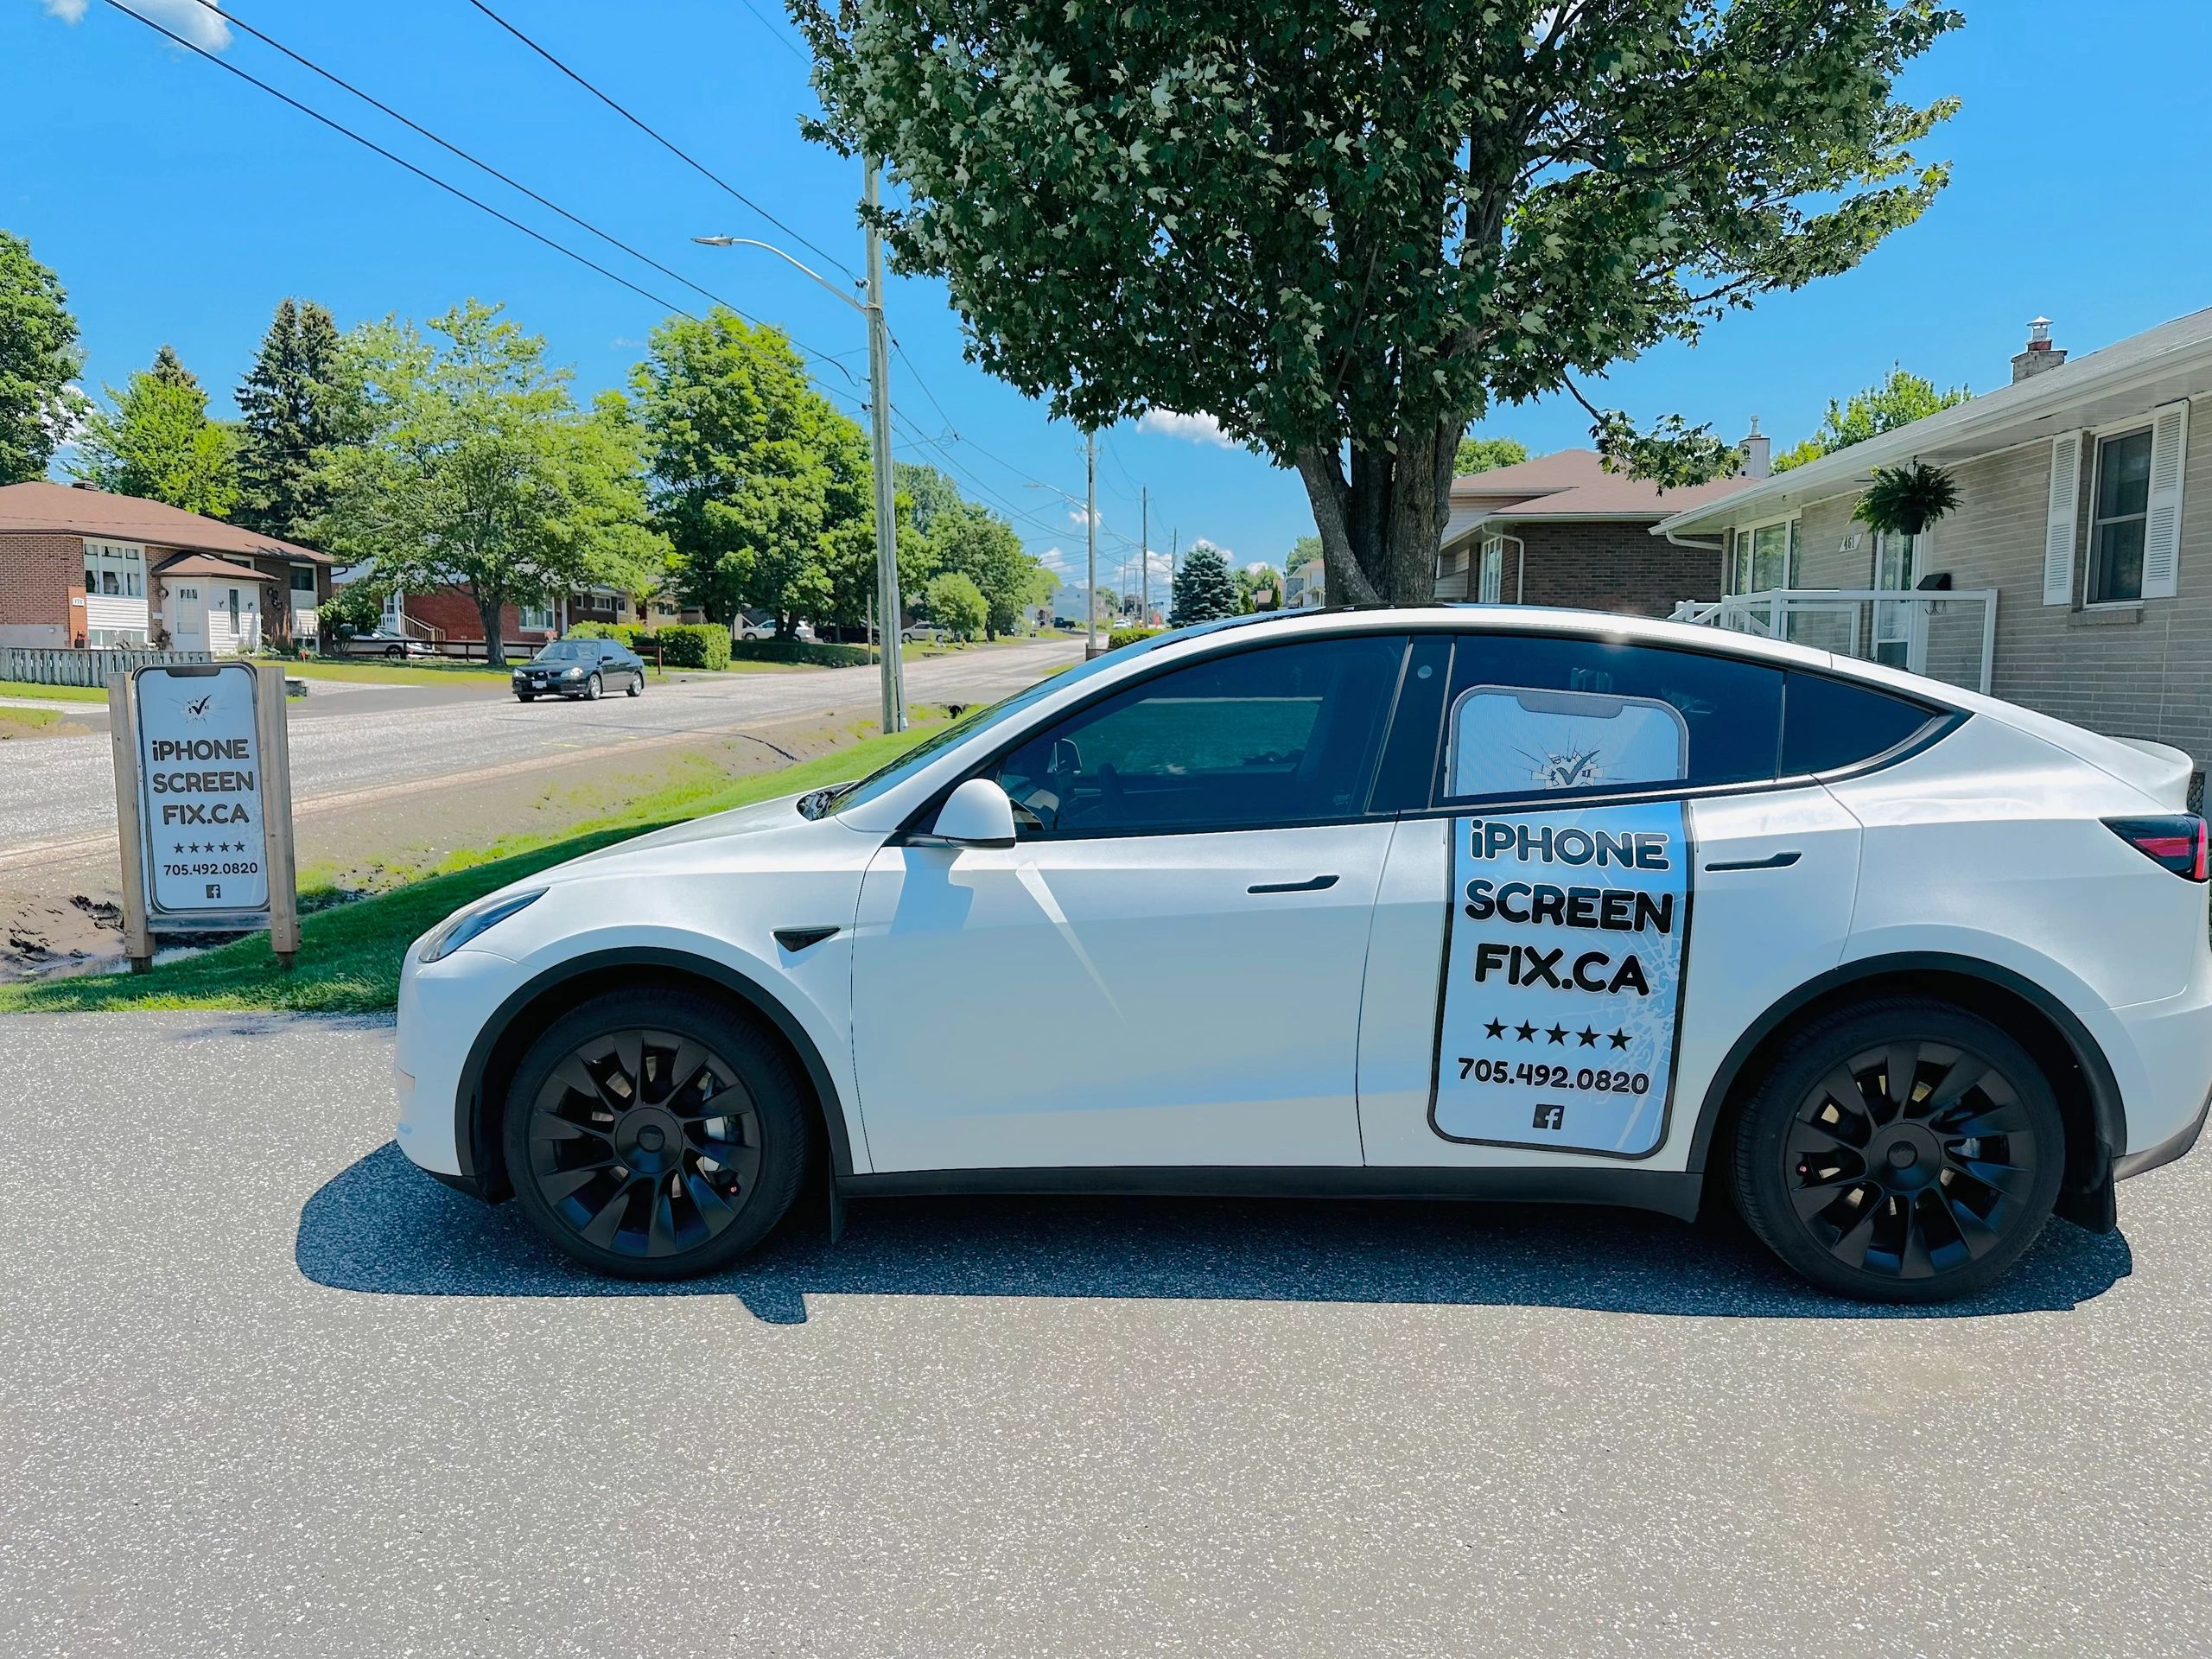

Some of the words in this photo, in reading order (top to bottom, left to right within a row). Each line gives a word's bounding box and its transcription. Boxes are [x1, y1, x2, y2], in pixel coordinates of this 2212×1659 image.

[1843, 536, 1854, 550] 461
[152, 739, 250, 761] iPHONE
[152, 772, 254, 793] SCREEN
[162, 804, 250, 825] FIX.CA
[1471, 819, 1669, 870] iPHONE
[163, 862, 258, 875] 705.492.0820
[1465, 880, 1674, 933] SCREEN
[1474, 944, 1650, 996] FIX.CA
[1458, 1057, 1649, 1095] 705.492.0820
